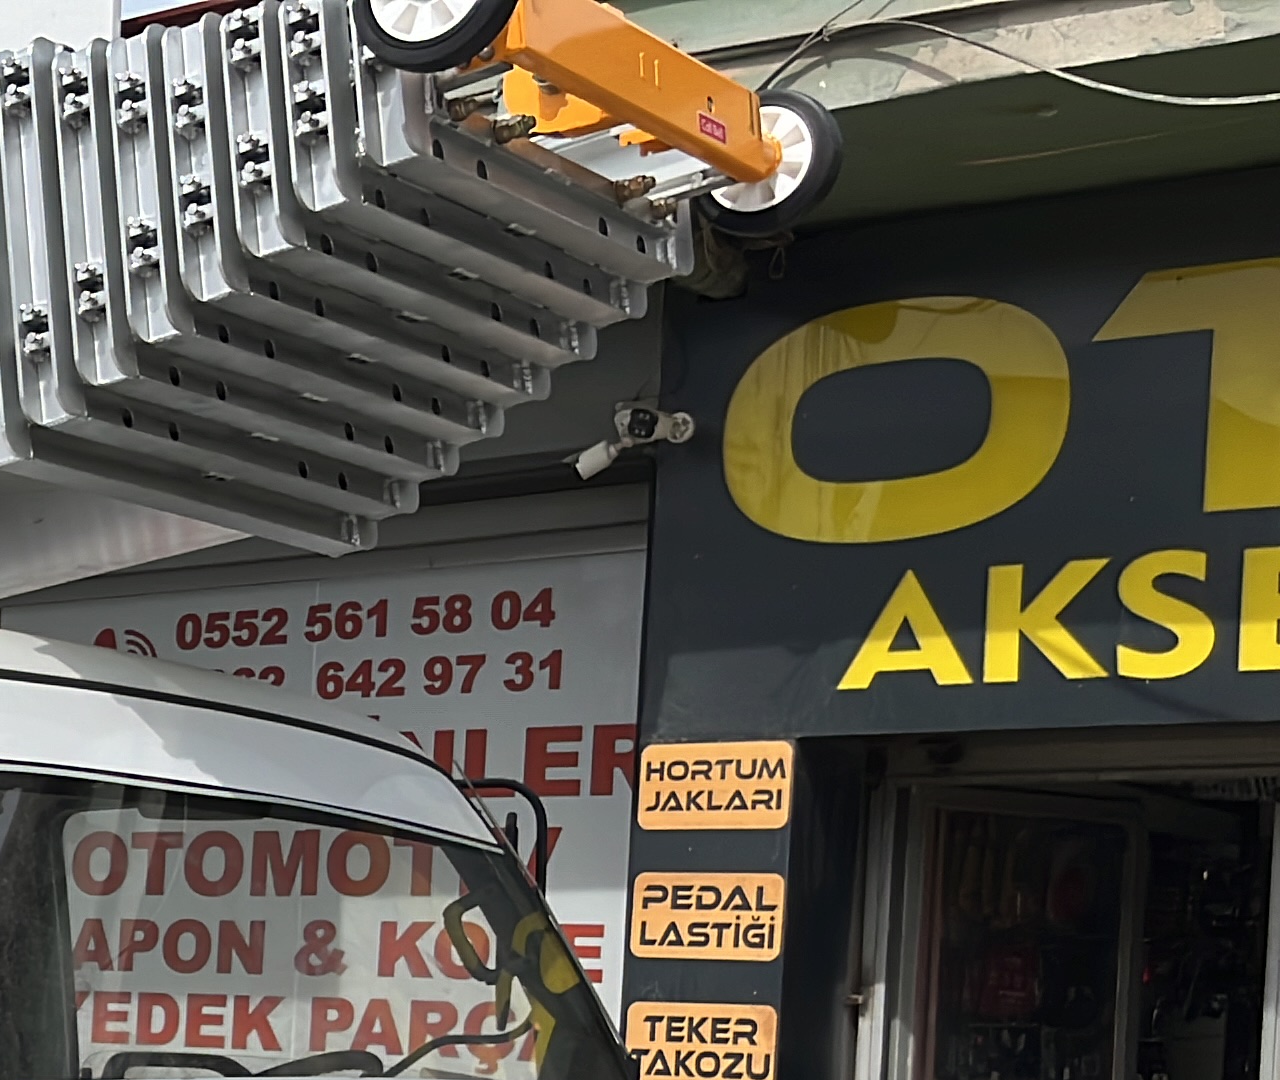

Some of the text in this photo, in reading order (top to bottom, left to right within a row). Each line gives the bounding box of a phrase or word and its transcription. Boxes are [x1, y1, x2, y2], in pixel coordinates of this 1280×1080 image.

[176, 587, 555, 650] 0552 561 58 04
[315, 658, 406, 700] 642
[423, 654, 487, 695] 97
[503, 649, 564, 691] 31
[645, 757, 786, 782] HORTUM
[645, 788, 783, 813] JAKLARI
[642, 884, 778, 912] PEDAL
[639, 915, 775, 950] LASTİĞİ
[73, 918, 606, 984] APON & KOE
[309, 997, 537, 1075] PARÇ
[643, 1015, 758, 1046] TEKER
[631, 1049, 771, 1080] TAKOZU
